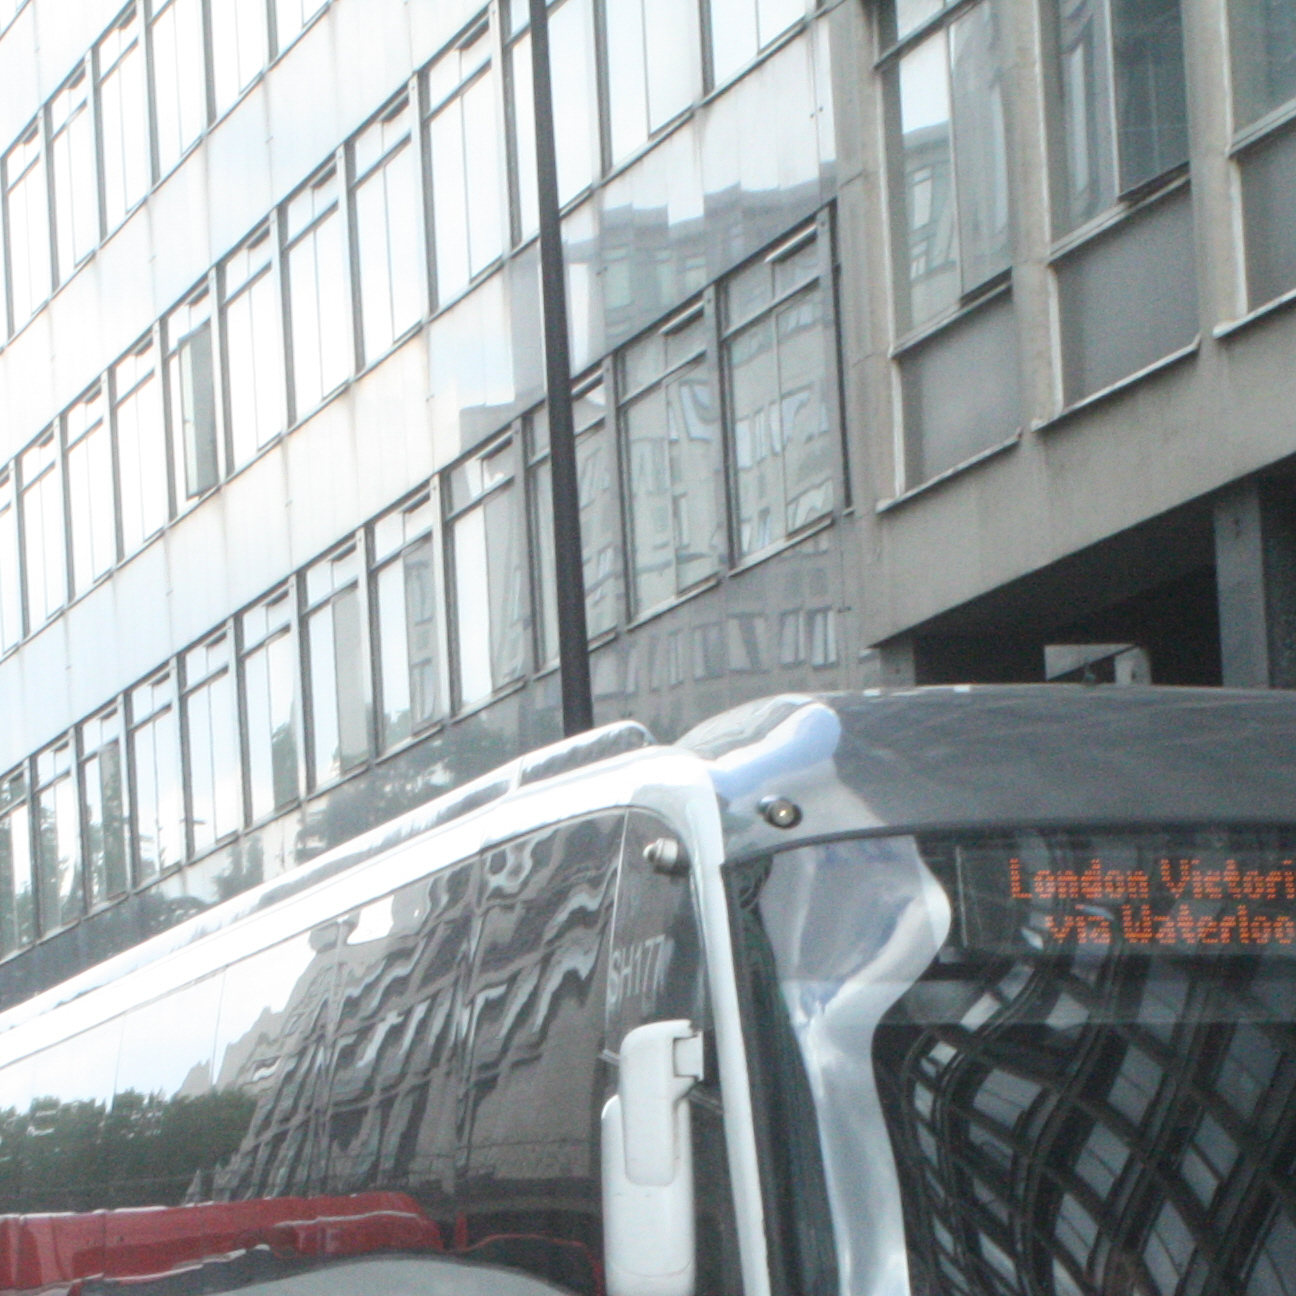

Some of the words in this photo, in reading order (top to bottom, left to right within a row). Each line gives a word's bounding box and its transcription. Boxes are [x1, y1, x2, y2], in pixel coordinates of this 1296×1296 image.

[1009, 858, 1149, 899] London
[1045, 904, 1112, 944] via
[1122, 904, 1296, 944] Waterloo
